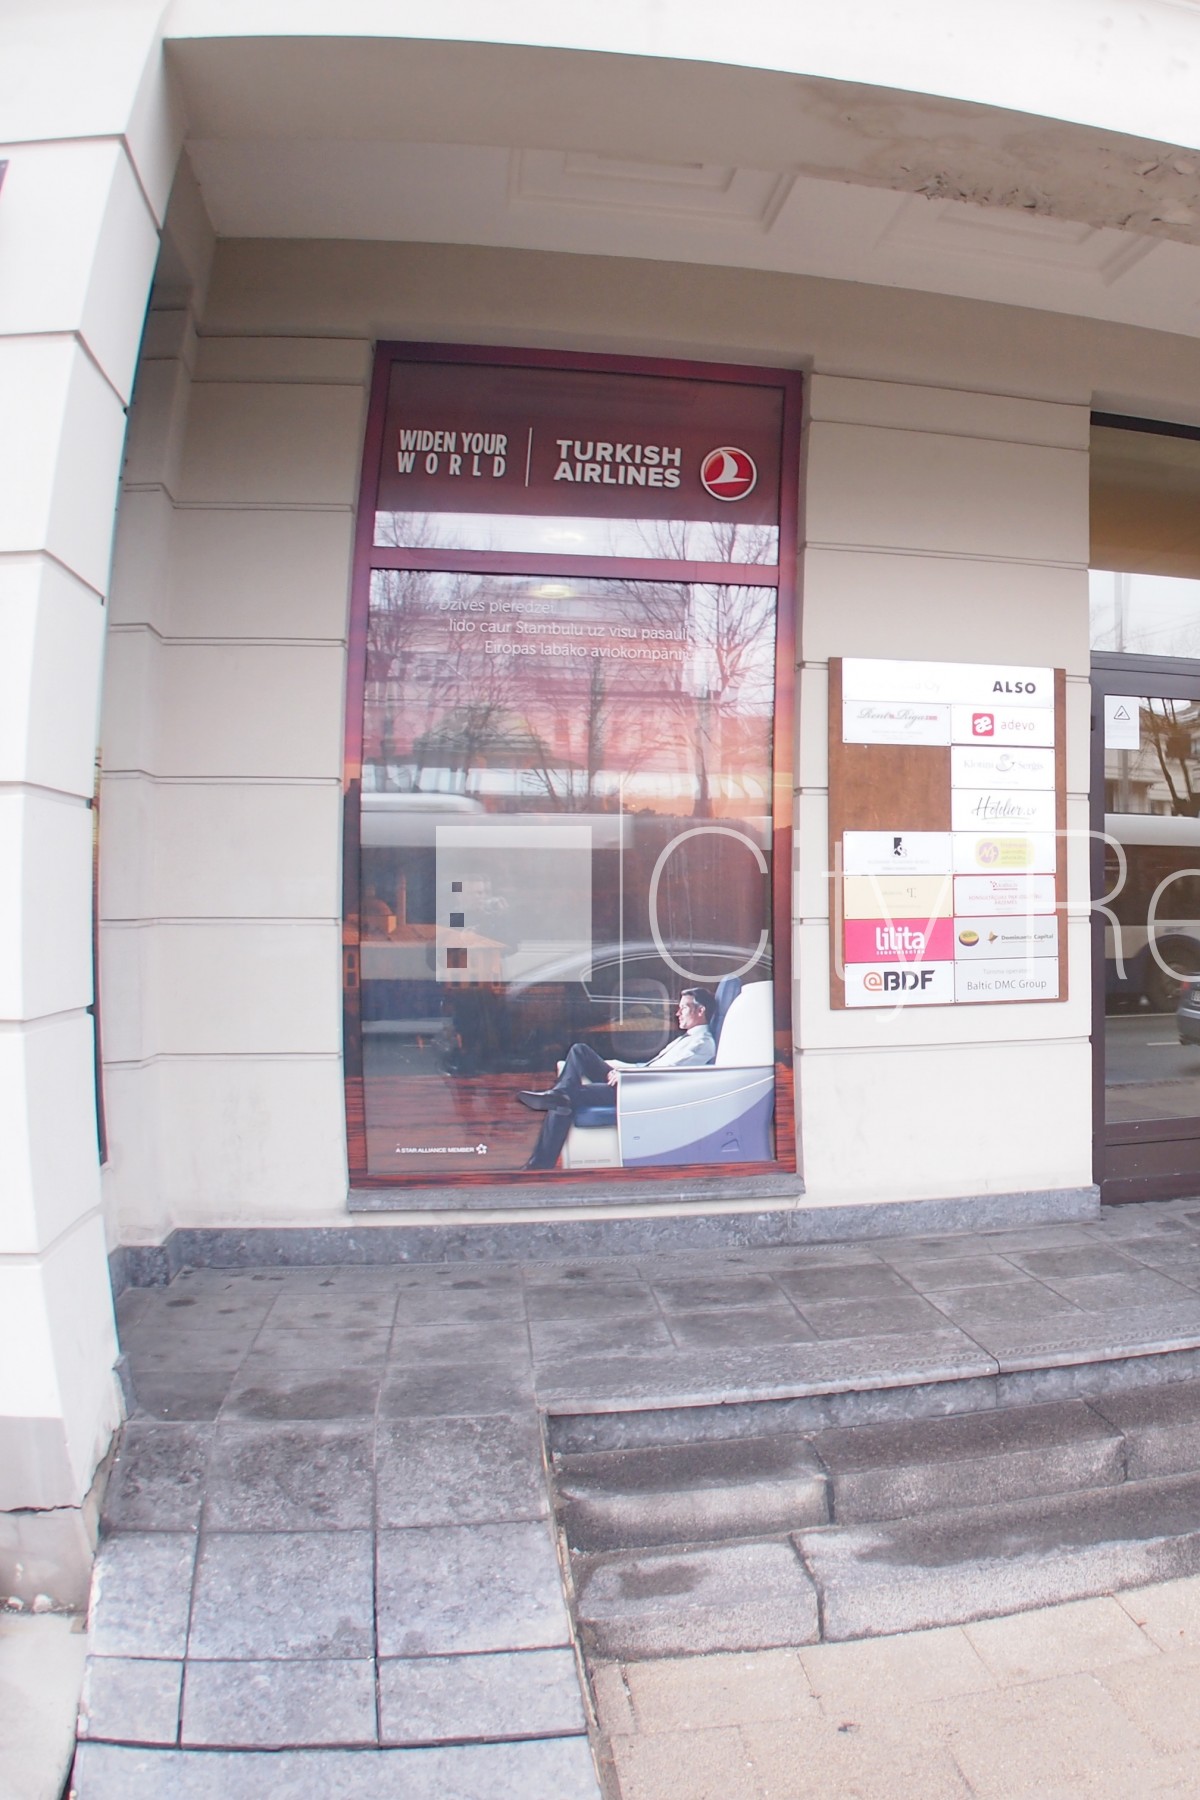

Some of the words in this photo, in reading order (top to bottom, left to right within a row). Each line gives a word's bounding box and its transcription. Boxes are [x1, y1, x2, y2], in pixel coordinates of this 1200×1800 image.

[400, 429, 456, 452] WIDEN
[461, 432, 507, 455] YOUR
[556, 440, 682, 467] TURKISH
[553, 461, 681, 488] AIRLINES
[480, 622, 512, 633] caur
[515, 620, 583, 637] Stambulu
[587, 625, 605, 637] uz
[609, 624, 638, 638] visu
[484, 640, 536, 657] Eiropas
[541, 641, 587, 657] labāko
[993, 681, 1036, 694] ALSO
[1001, 719, 1035, 731] adevo
[875, 927, 925, 951] lilita
[863, 969, 935, 991] @BDF
[967, 980, 992, 991] Baltic
[995, 979, 1016, 989] DMC
[1018, 979, 1047, 991] Group
